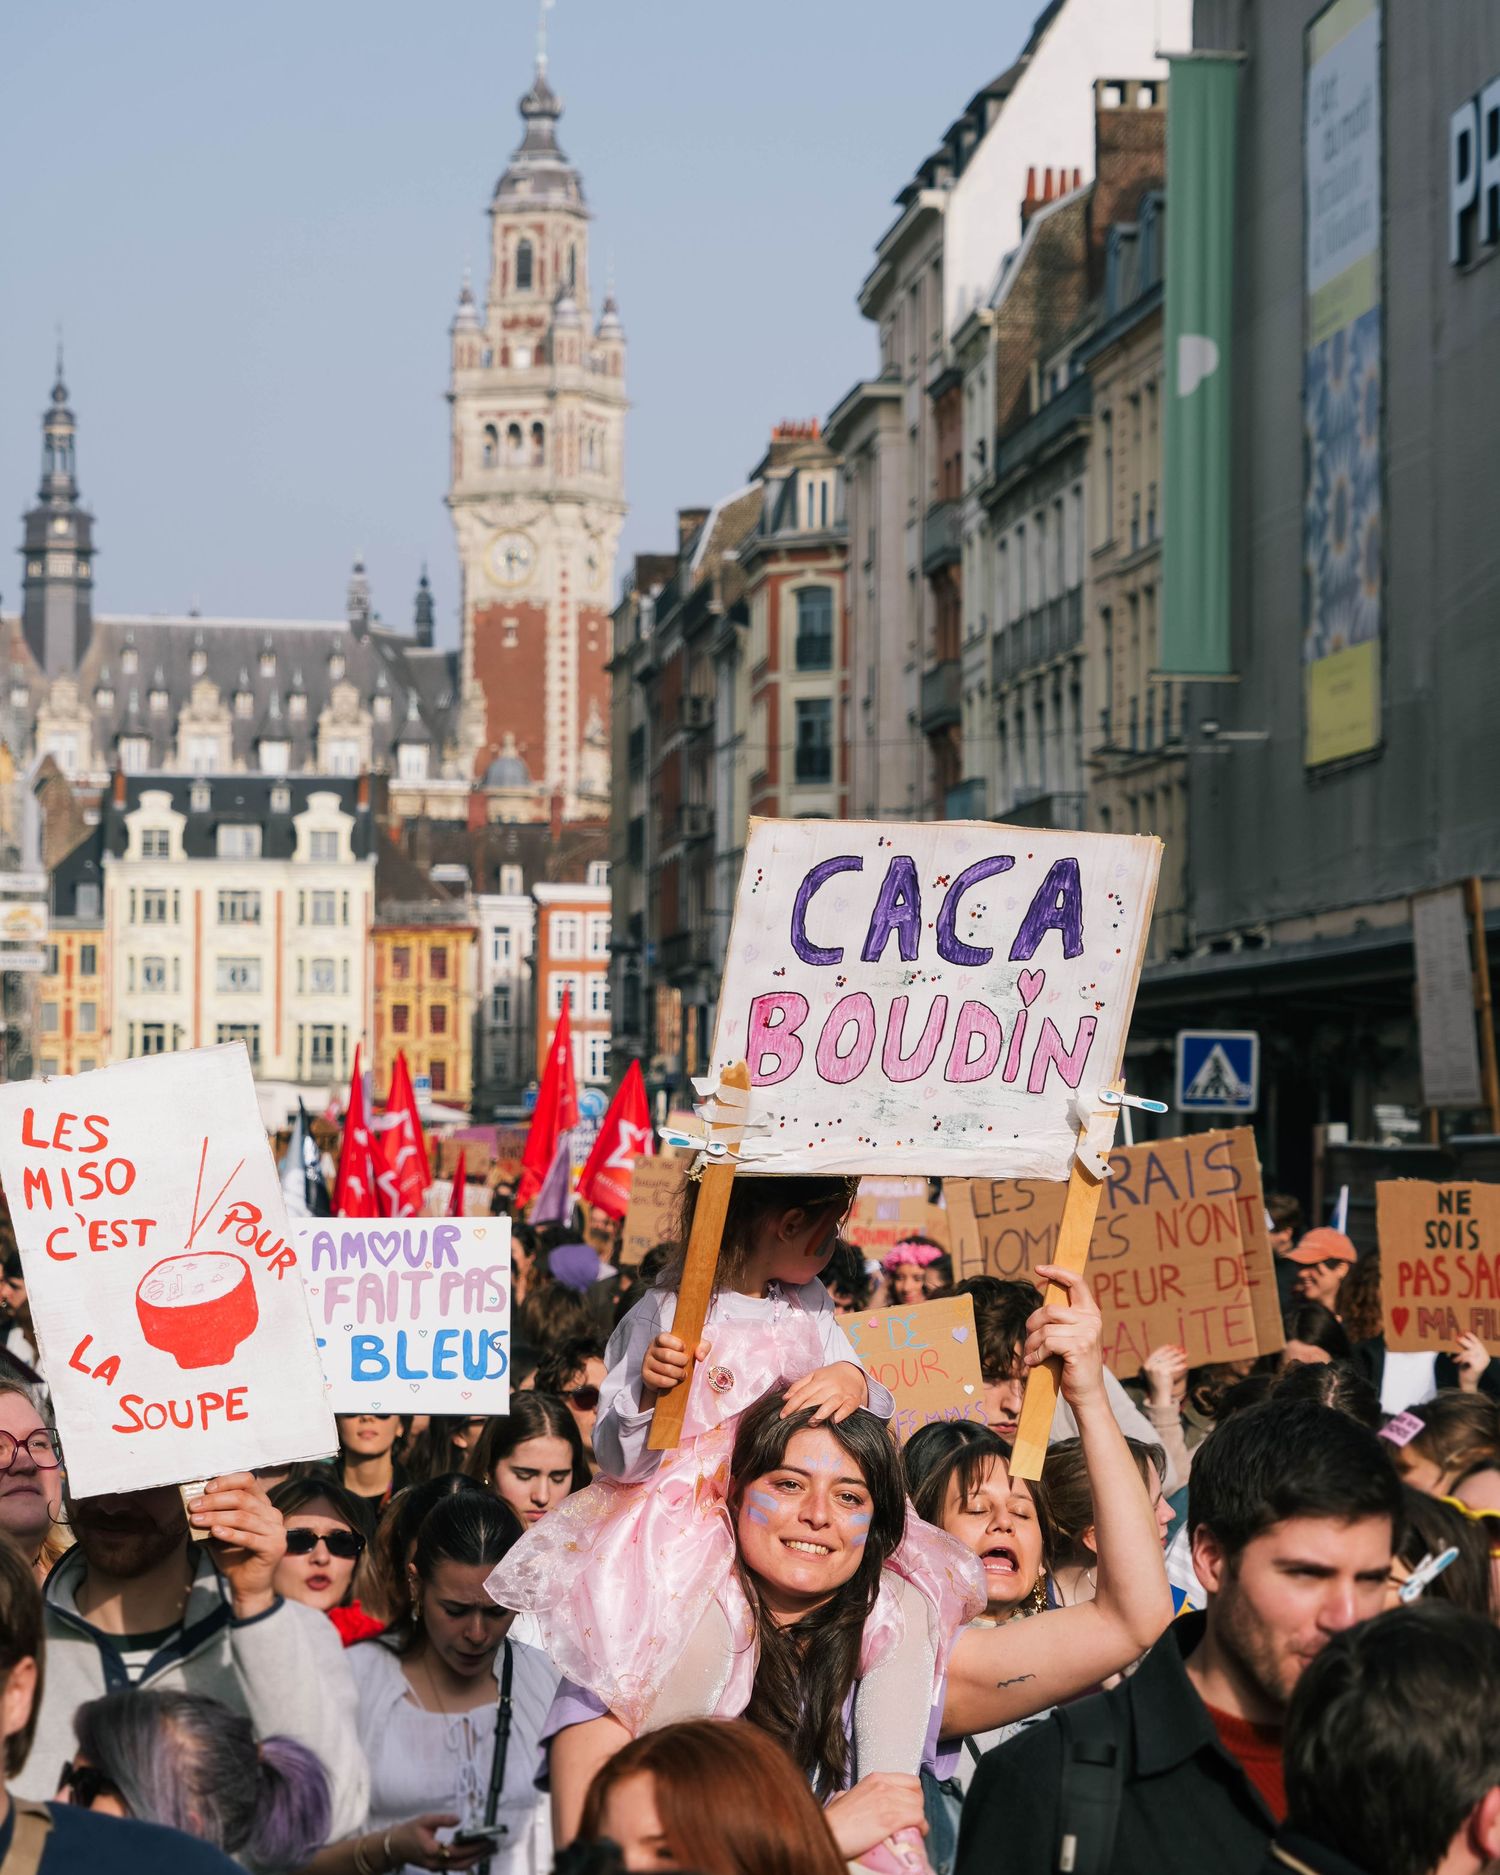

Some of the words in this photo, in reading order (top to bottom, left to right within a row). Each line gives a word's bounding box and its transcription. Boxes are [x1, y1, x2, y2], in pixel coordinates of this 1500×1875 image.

[791, 855, 1084, 966] CACA
[745, 968, 1097, 1094] BOUDIN
[22, 1108, 109, 1153] LES
[24, 1158, 136, 1210] MISO
[971, 1179, 1035, 1219] LES
[1108, 1140, 1241, 1209] RAIS
[1437, 1190, 1471, 1215] NE
[46, 1213, 157, 1261] C'EST
[217, 1201, 297, 1280] POUR
[960, 1214, 1130, 1278] HOMES
[1155, 1195, 1258, 1250] N'ONT
[1425, 1220, 1479, 1250] SOIS
[324, 1270, 433, 1325] FAIT
[439, 1265, 509, 1316] PAS
[1093, 1264, 1185, 1309] PEUR
[1215, 1251, 1260, 1291] DE
[1398, 1255, 1451, 1297] PAS
[888, 1313, 929, 1350] DE
[1417, 1306, 1460, 1341] MA
[69, 1335, 121, 1386] LA
[351, 1329, 508, 1381] BLEUS
[112, 1387, 249, 1434] SOUPE
